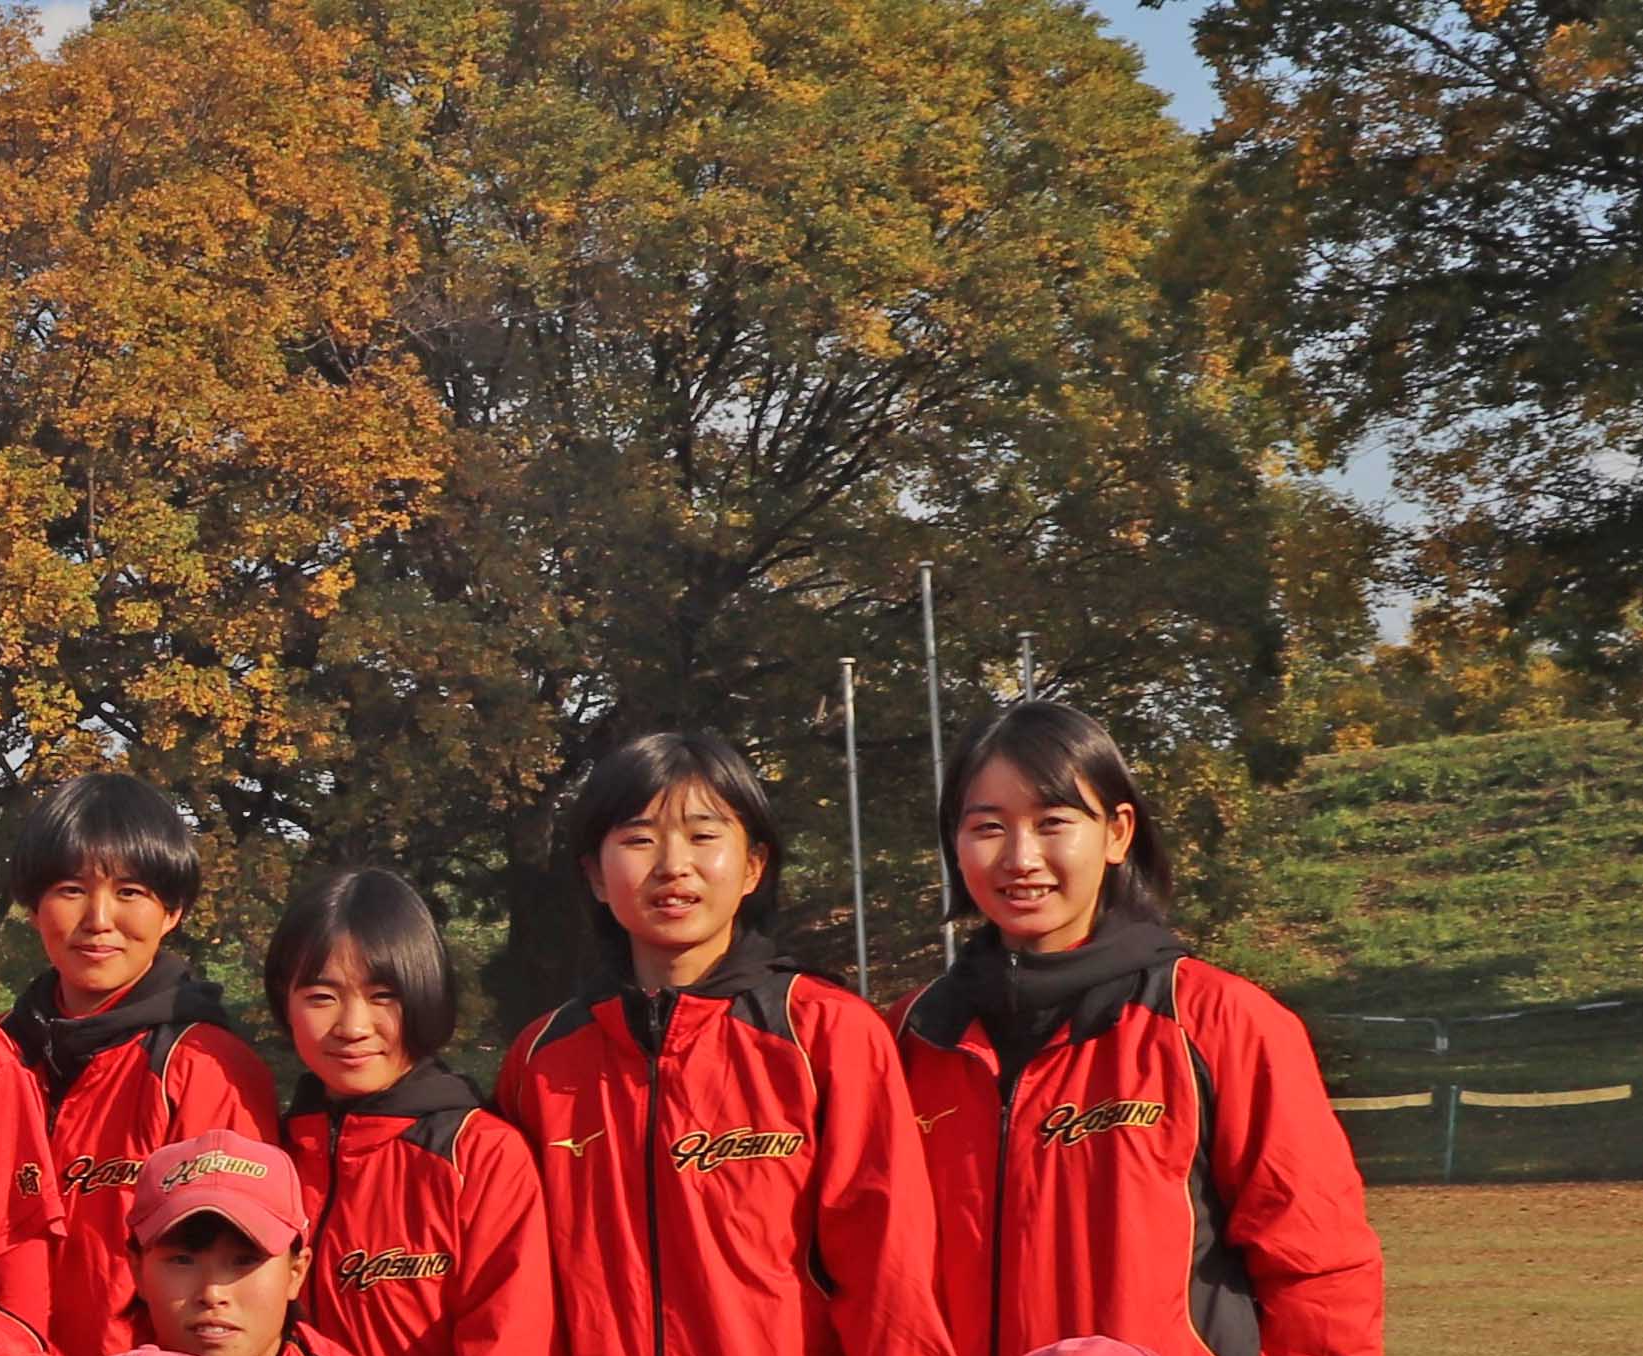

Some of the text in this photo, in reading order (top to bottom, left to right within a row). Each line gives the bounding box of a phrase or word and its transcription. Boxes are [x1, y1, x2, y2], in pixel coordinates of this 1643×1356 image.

[1040, 1098, 1166, 1149] HOSHINO
[162, 1149, 269, 1191] HOSHINO
[670, 1127, 805, 1174] HOSHINO
[337, 1246, 453, 1293] HOSHINO
